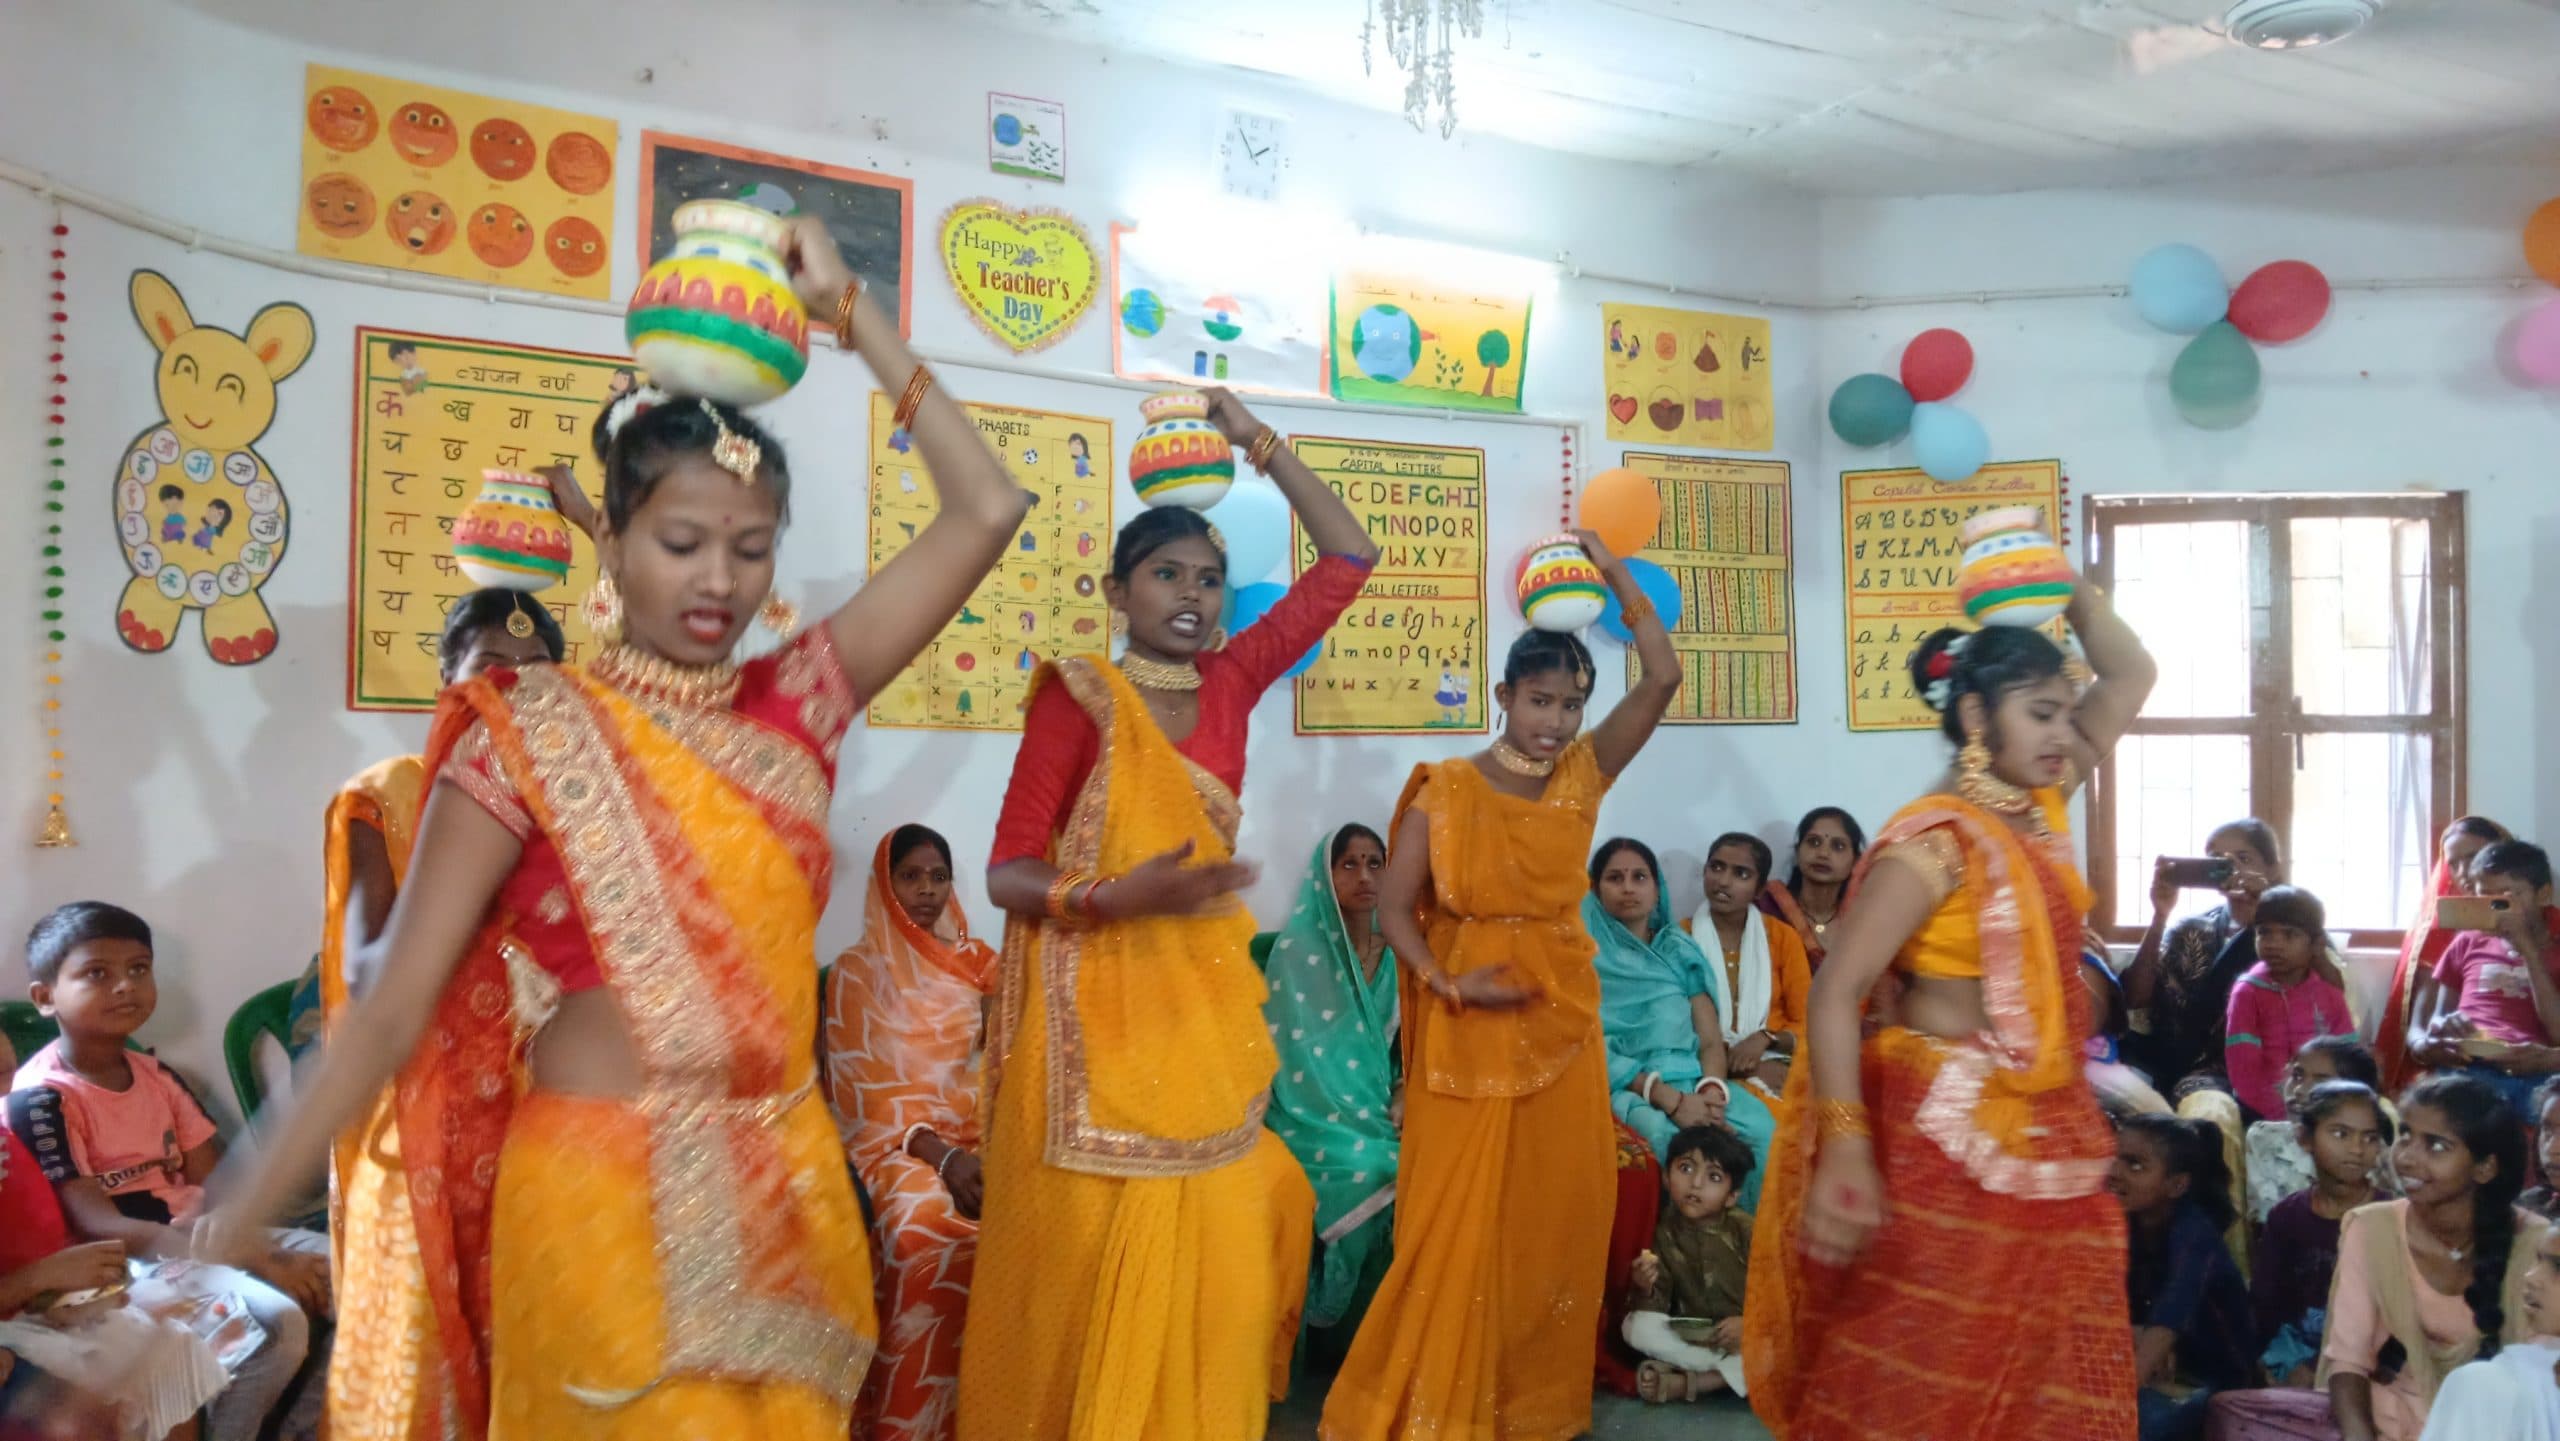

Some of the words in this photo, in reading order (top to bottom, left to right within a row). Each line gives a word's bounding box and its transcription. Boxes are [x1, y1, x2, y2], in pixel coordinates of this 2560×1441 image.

[964, 230, 1025, 261] Happy
[977, 261, 1070, 301] Teacher's
[1003, 295, 1043, 326] Day
[376, 390, 404, 418] क
[442, 399, 475, 421] ख
[508, 406, 534, 429] ग
[971, 417, 1031, 437] PHABETS
[439, 437, 469, 461] छ
[495, 445, 527, 468] ज
[1340, 458, 1386, 474] CAPITAL
[1396, 461, 1443, 476] LETTERS
[382, 470, 419, 495] ट
[440, 477, 467, 499] ठ
[875, 465, 884, 477] C
[1055, 485, 1063, 497] F
[1348, 481, 1363, 503] C
[1371, 482, 1386, 504] D
[1390, 483, 1404, 505] E
[1408, 484, 1422, 505] F
[1425, 485, 1444, 507] G
[1446, 487, 1462, 508] H
[1463, 487, 1479, 508] I
[384, 511, 422, 537] त
[1367, 514, 1387, 536] M
[1390, 514, 1407, 536] N
[1409, 515, 1422, 535] O
[1426, 515, 1439, 537] P
[1442, 517, 1457, 538] Q
[1462, 518, 1475, 538] R
[377, 549, 415, 575] प
[1304, 543, 1316, 564] S
[1389, 546, 1407, 567] W
[1413, 546, 1427, 567] X
[1433, 547, 1447, 567] Y
[1450, 547, 1469, 569] Z
[1053, 567, 1062, 578] N
[377, 589, 413, 615] य
[1362, 583, 1386, 596] ALL
[1391, 584, 1440, 597] LETTERS
[1347, 614, 1357, 627] c
[1364, 606, 1376, 627] d
[1381, 613, 1395, 627] e
[1401, 605, 1413, 627] f
[1407, 613, 1424, 640] g
[1431, 606, 1444, 628] h
[369, 630, 401, 655] ष
[993, 646, 1001, 656] U
[1343, 648, 1358, 657] m
[1366, 647, 1378, 658] n
[1383, 646, 1393, 658] o
[1399, 645, 1410, 667] p
[1417, 645, 1430, 667] q
[1435, 647, 1442, 658] r
[1450, 646, 1457, 659] s
[1463, 642, 1472, 659] t
[932, 686, 942, 697] X
